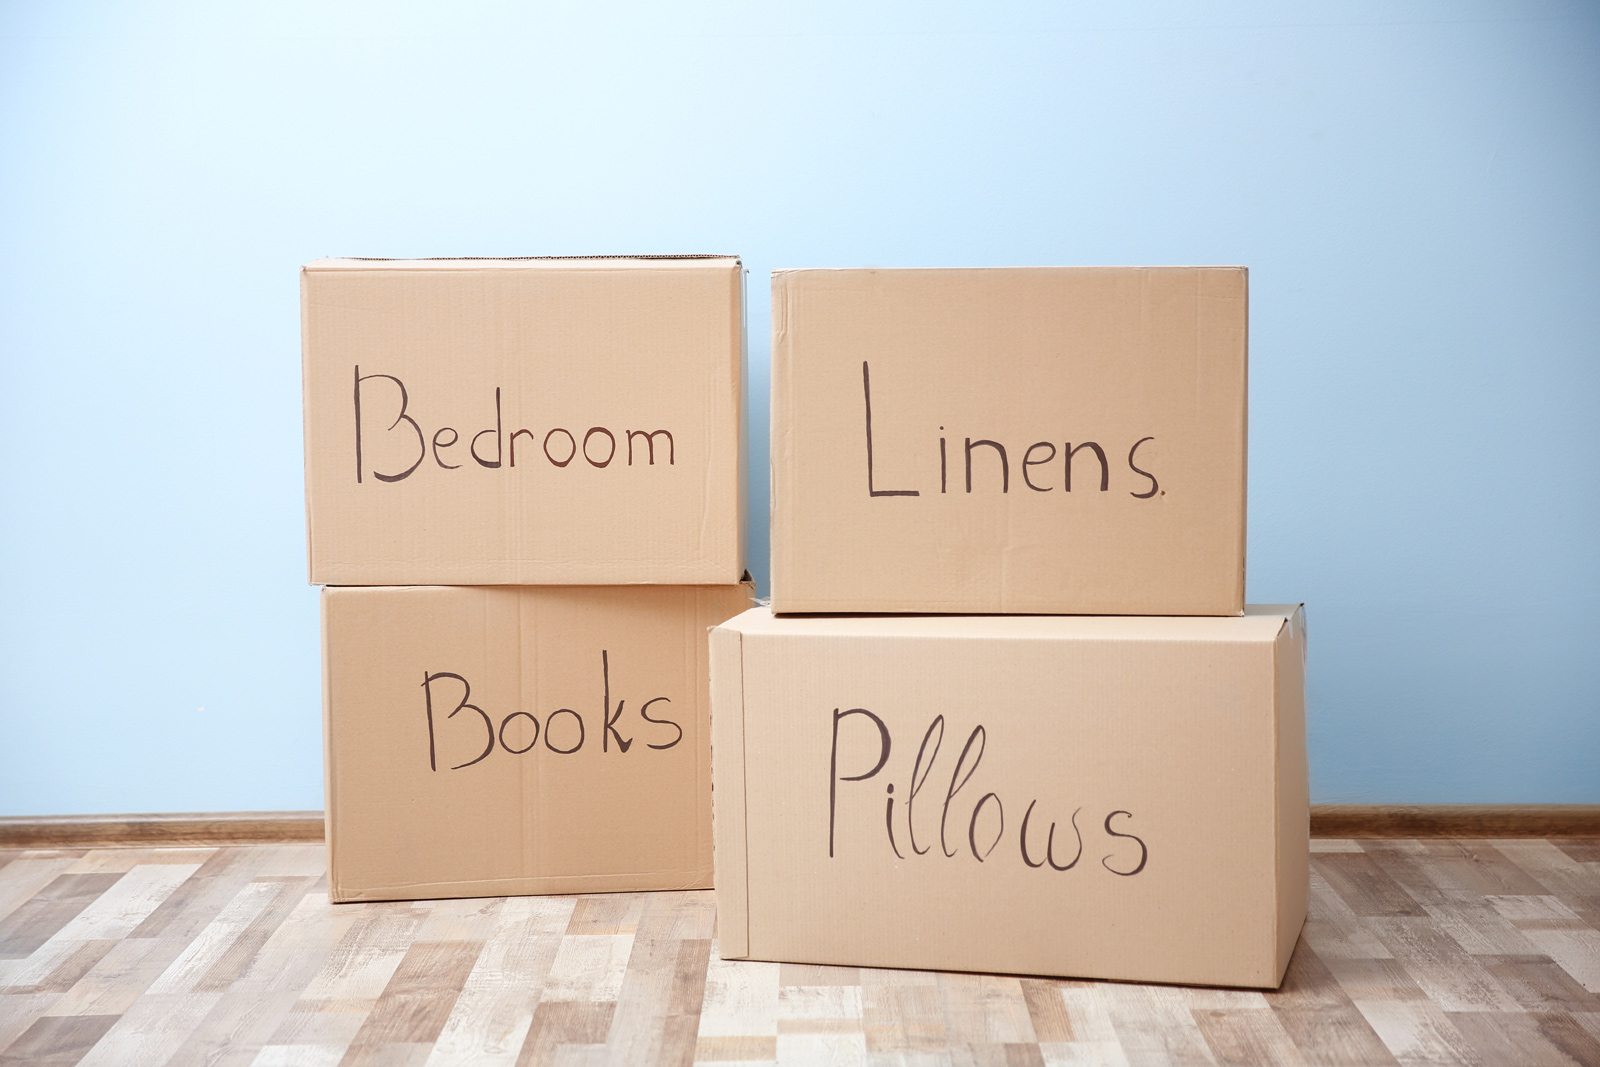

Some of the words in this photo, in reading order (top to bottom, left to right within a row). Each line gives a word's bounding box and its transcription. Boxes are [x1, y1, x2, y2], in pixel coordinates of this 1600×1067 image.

[353, 364, 675, 484] Bedroom
[420, 649, 683, 773] Books
[829, 707, 1148, 877] Pillows
